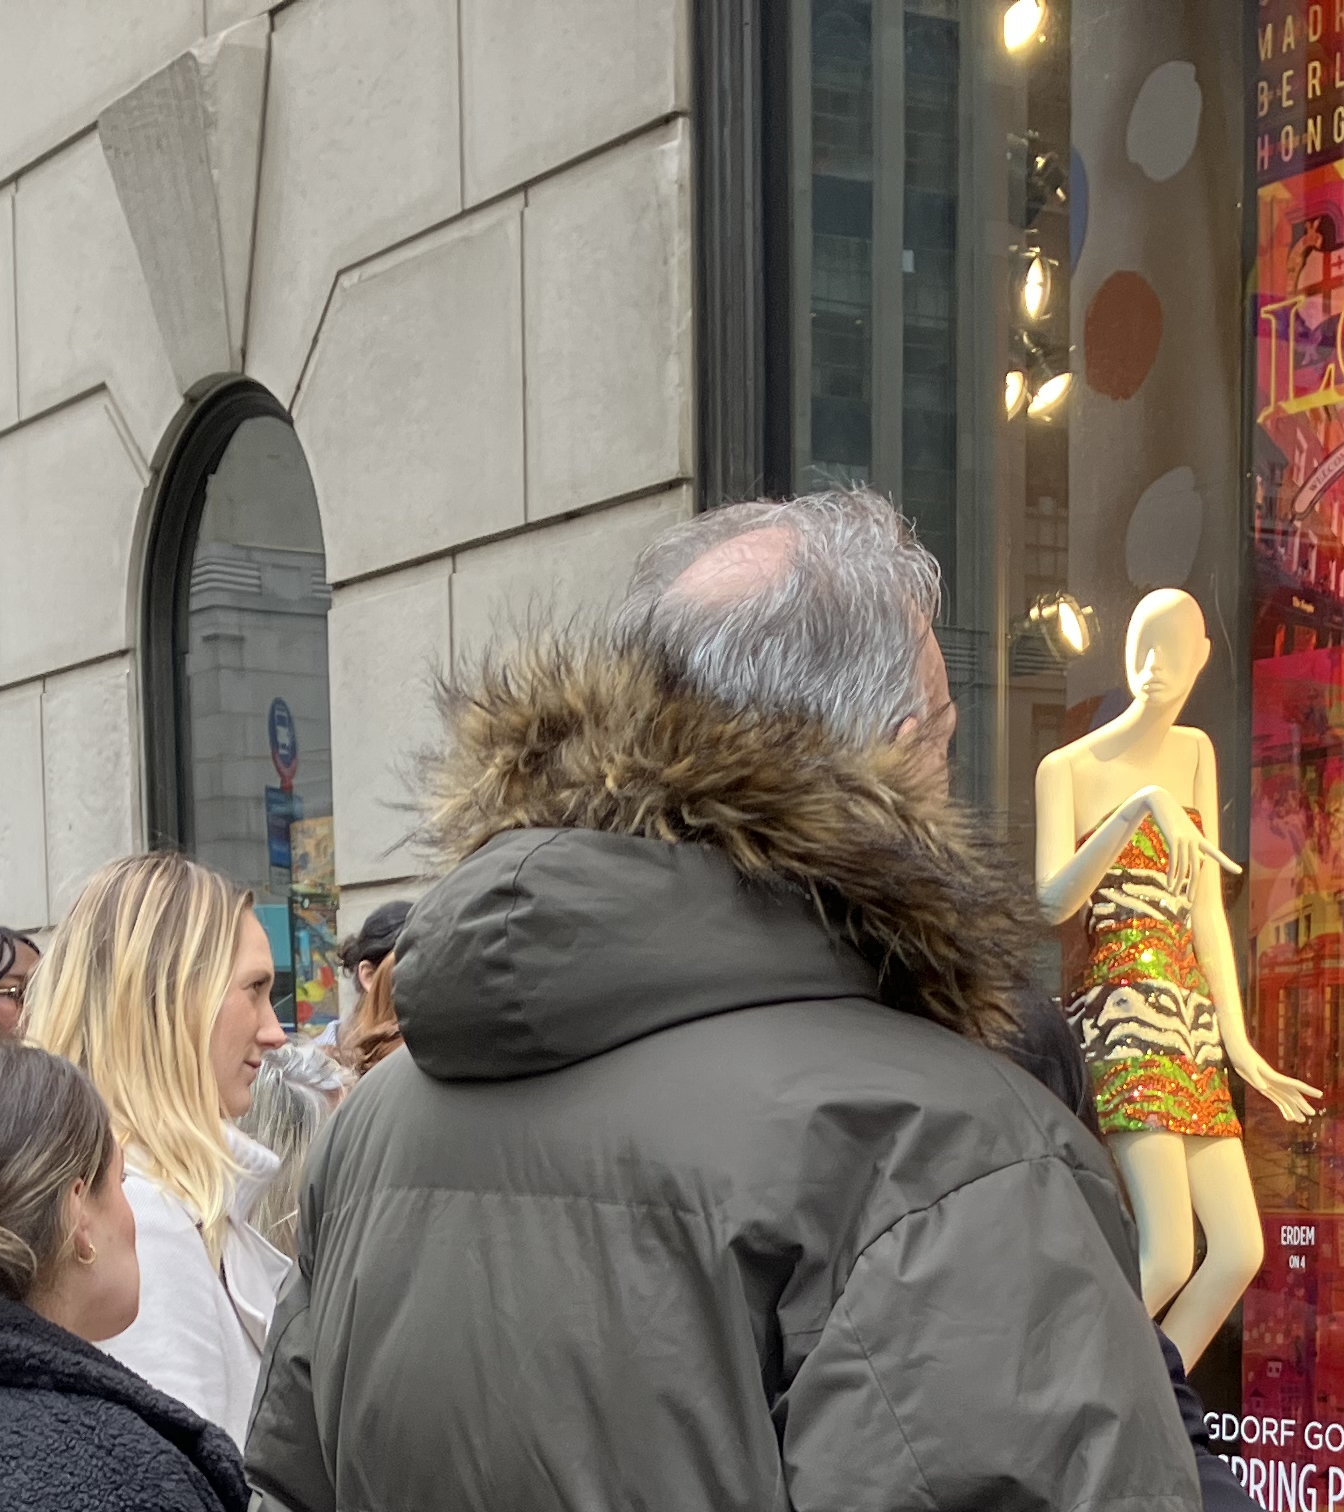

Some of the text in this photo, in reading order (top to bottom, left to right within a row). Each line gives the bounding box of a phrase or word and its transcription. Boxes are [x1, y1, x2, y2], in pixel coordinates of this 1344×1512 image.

[1281, 1225, 1315, 1246] ERDEM
[1288, 1255, 1306, 1269] ON 4
[1203, 1411, 1296, 1446] GDORF
